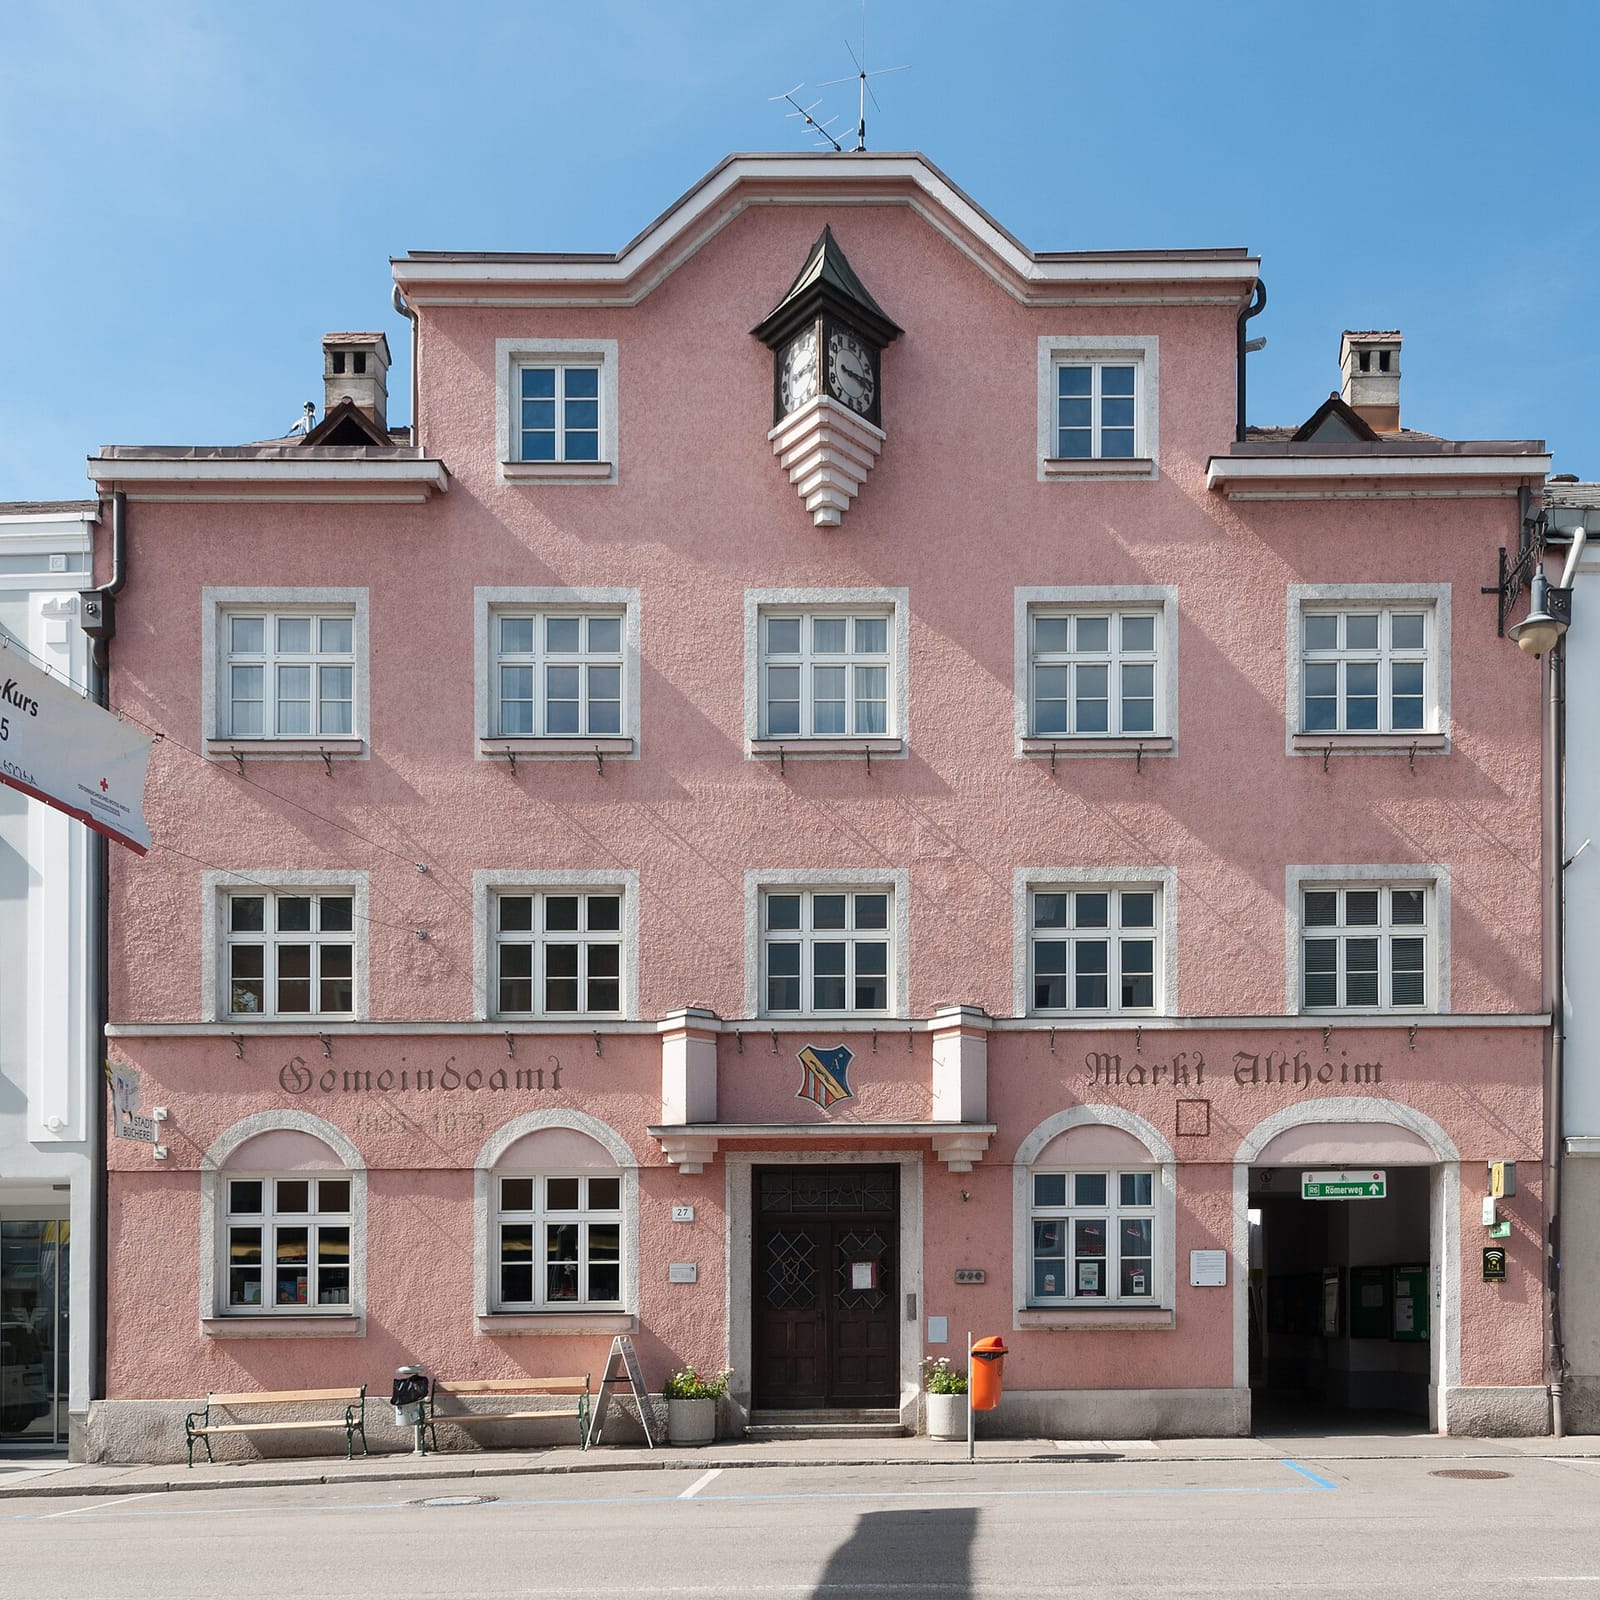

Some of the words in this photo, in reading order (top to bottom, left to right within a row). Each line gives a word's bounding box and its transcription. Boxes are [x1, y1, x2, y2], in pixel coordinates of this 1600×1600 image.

[0, 678, 39, 717] Kurs
[278, 1055, 565, 1095] Gemeindeamt
[1085, 1051, 1207, 1087] Markt
[1232, 1051, 1384, 1091] Altheim
[1325, 1185, 1363, 1196] Römerweg
[677, 1208, 689, 1217] 27
